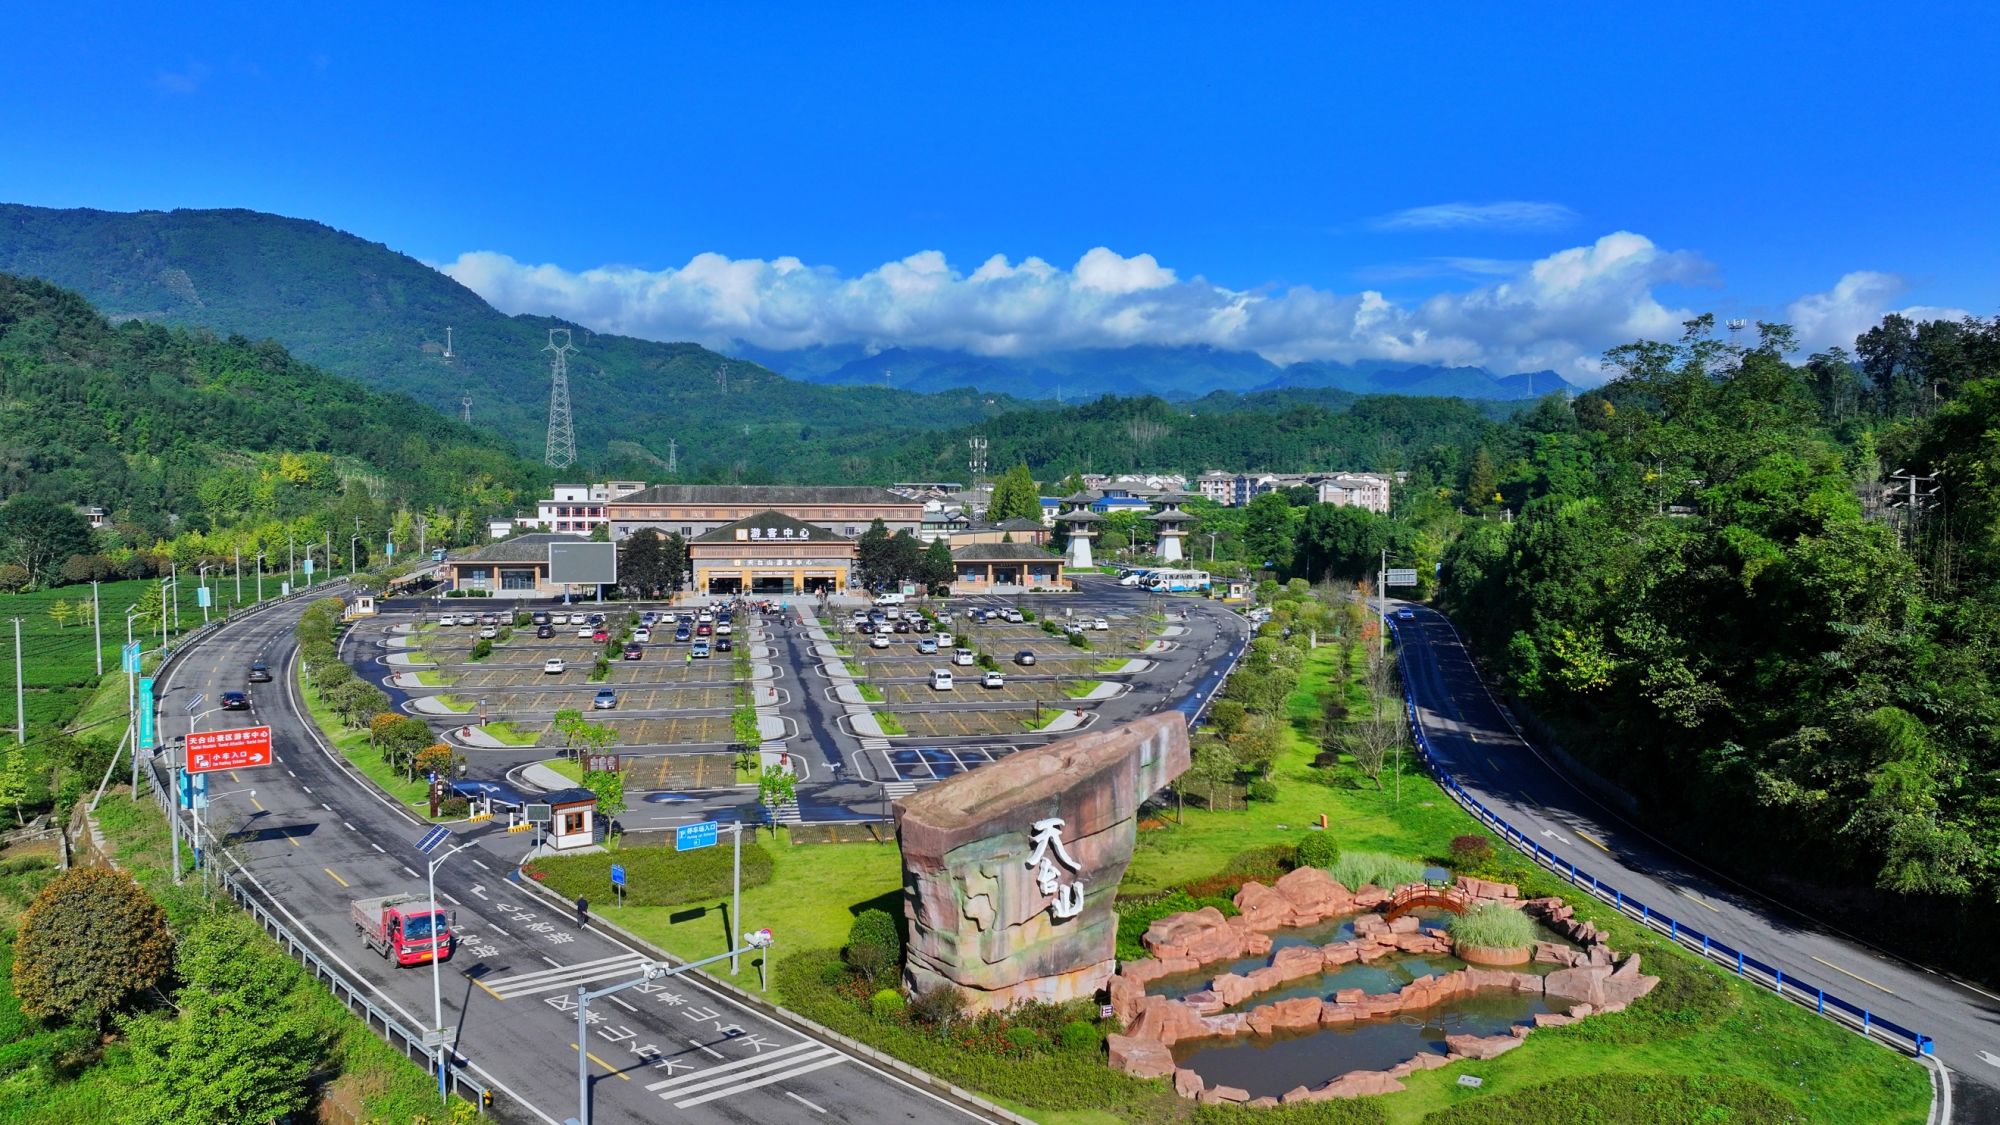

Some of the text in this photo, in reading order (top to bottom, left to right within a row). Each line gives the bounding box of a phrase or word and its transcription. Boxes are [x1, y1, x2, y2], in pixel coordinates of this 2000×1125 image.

[750, 527, 810, 538] 游客中心
[189, 731, 269, 744] 天台山景区游客中心
[212, 751, 247, 761] 小车入口
[1025, 817, 1084, 921] 天台山
